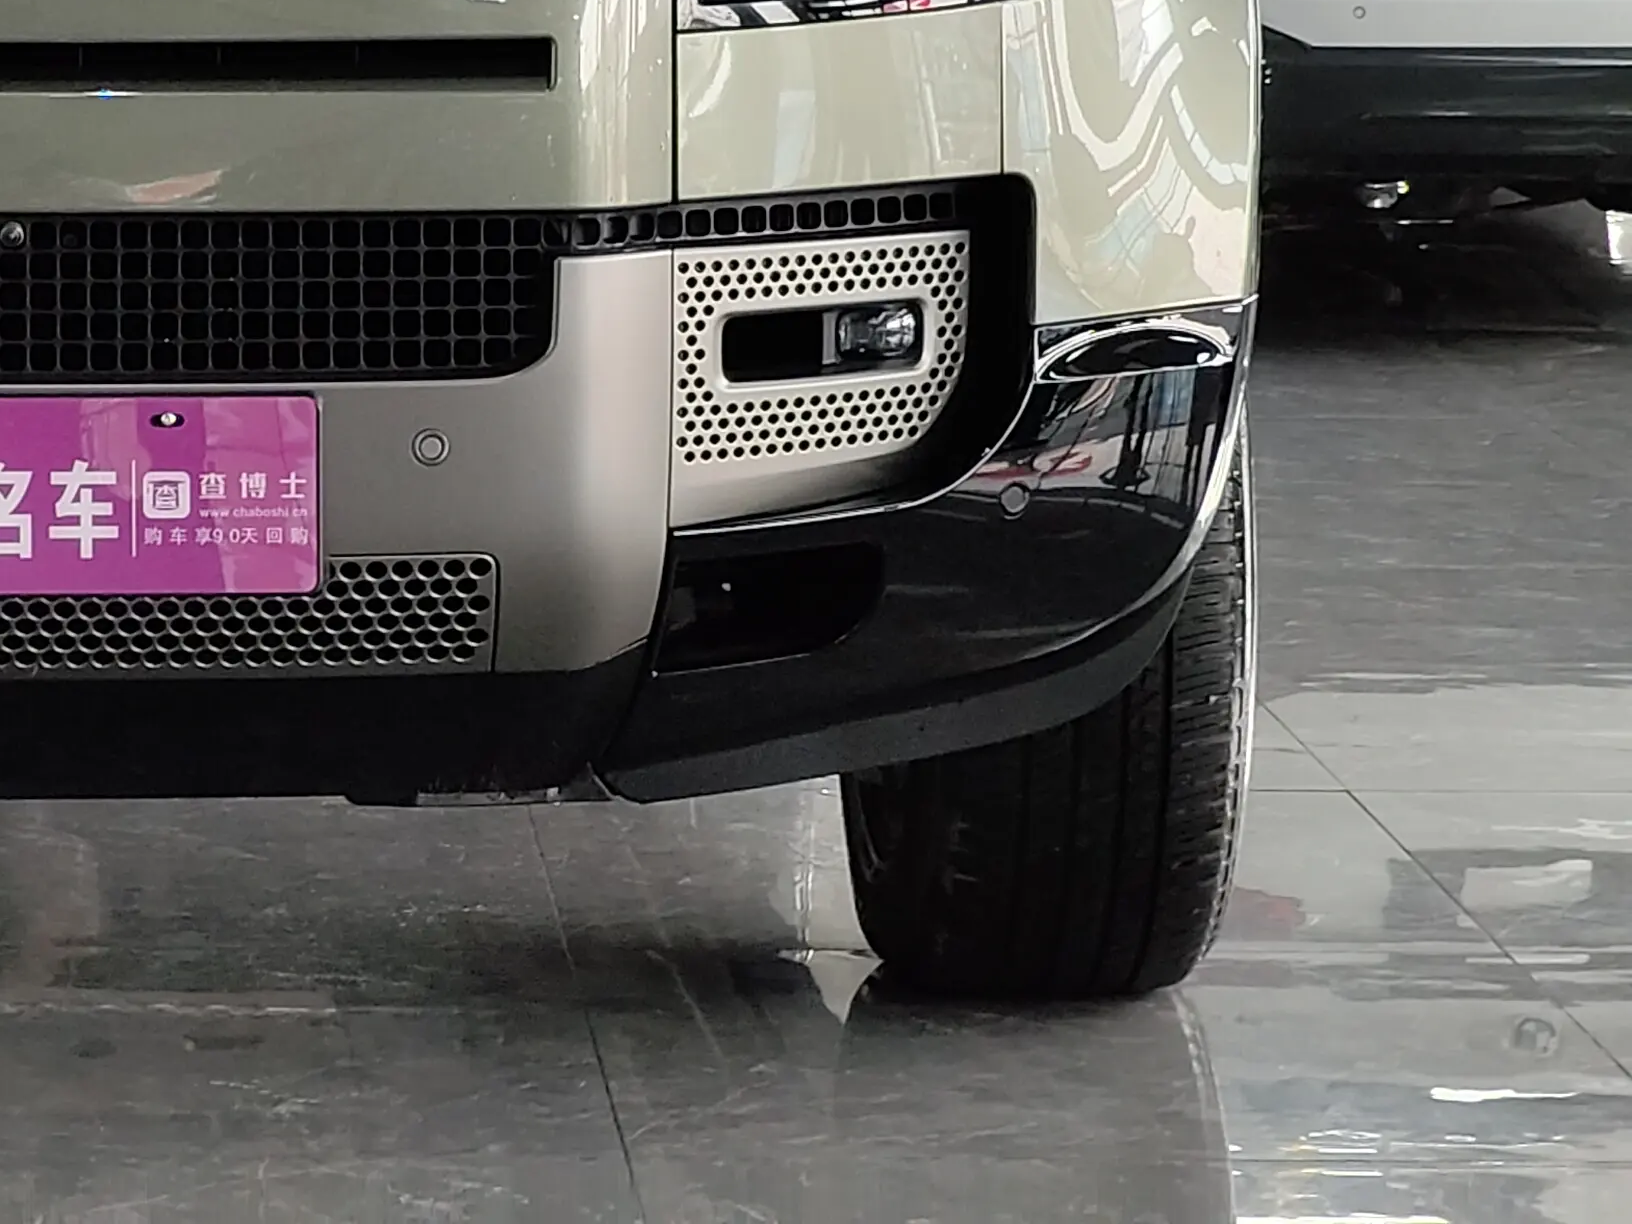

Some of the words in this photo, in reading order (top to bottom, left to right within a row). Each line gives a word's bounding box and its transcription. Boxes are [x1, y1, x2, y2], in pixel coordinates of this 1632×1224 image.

[199, 472, 307, 499] 查博士
[199, 507, 308, 518] wwwchaboshicn
